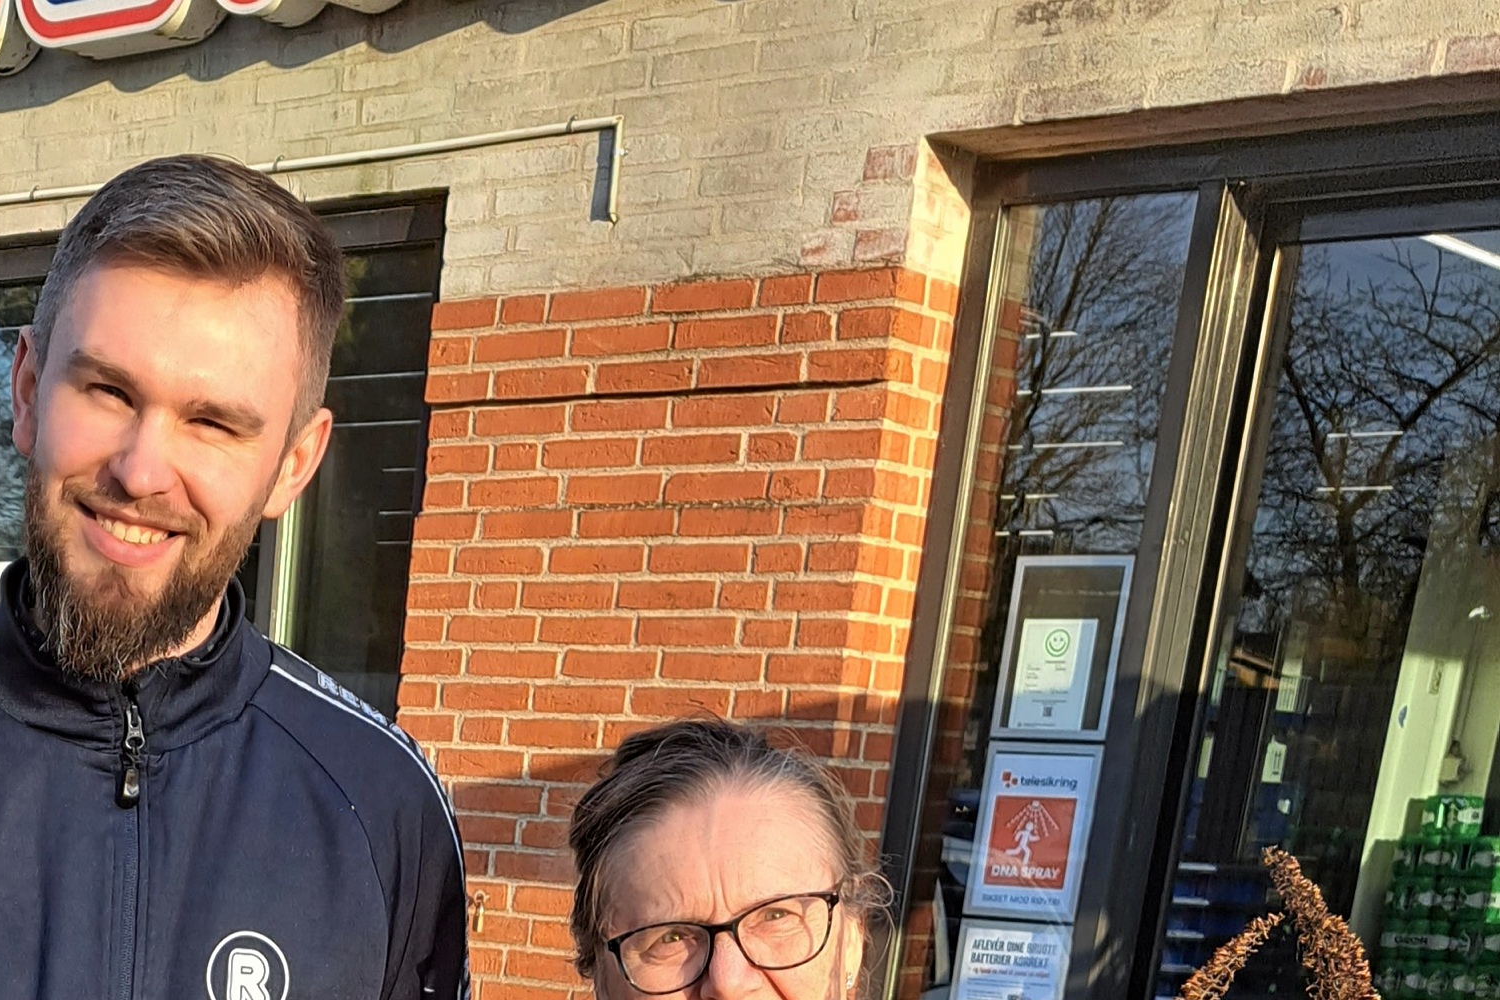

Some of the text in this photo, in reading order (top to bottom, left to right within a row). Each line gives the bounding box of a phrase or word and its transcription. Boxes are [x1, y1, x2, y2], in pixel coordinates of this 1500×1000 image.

[1020, 776, 1078, 791] telesikring
[990, 864, 1061, 879] DNA SPRAY
